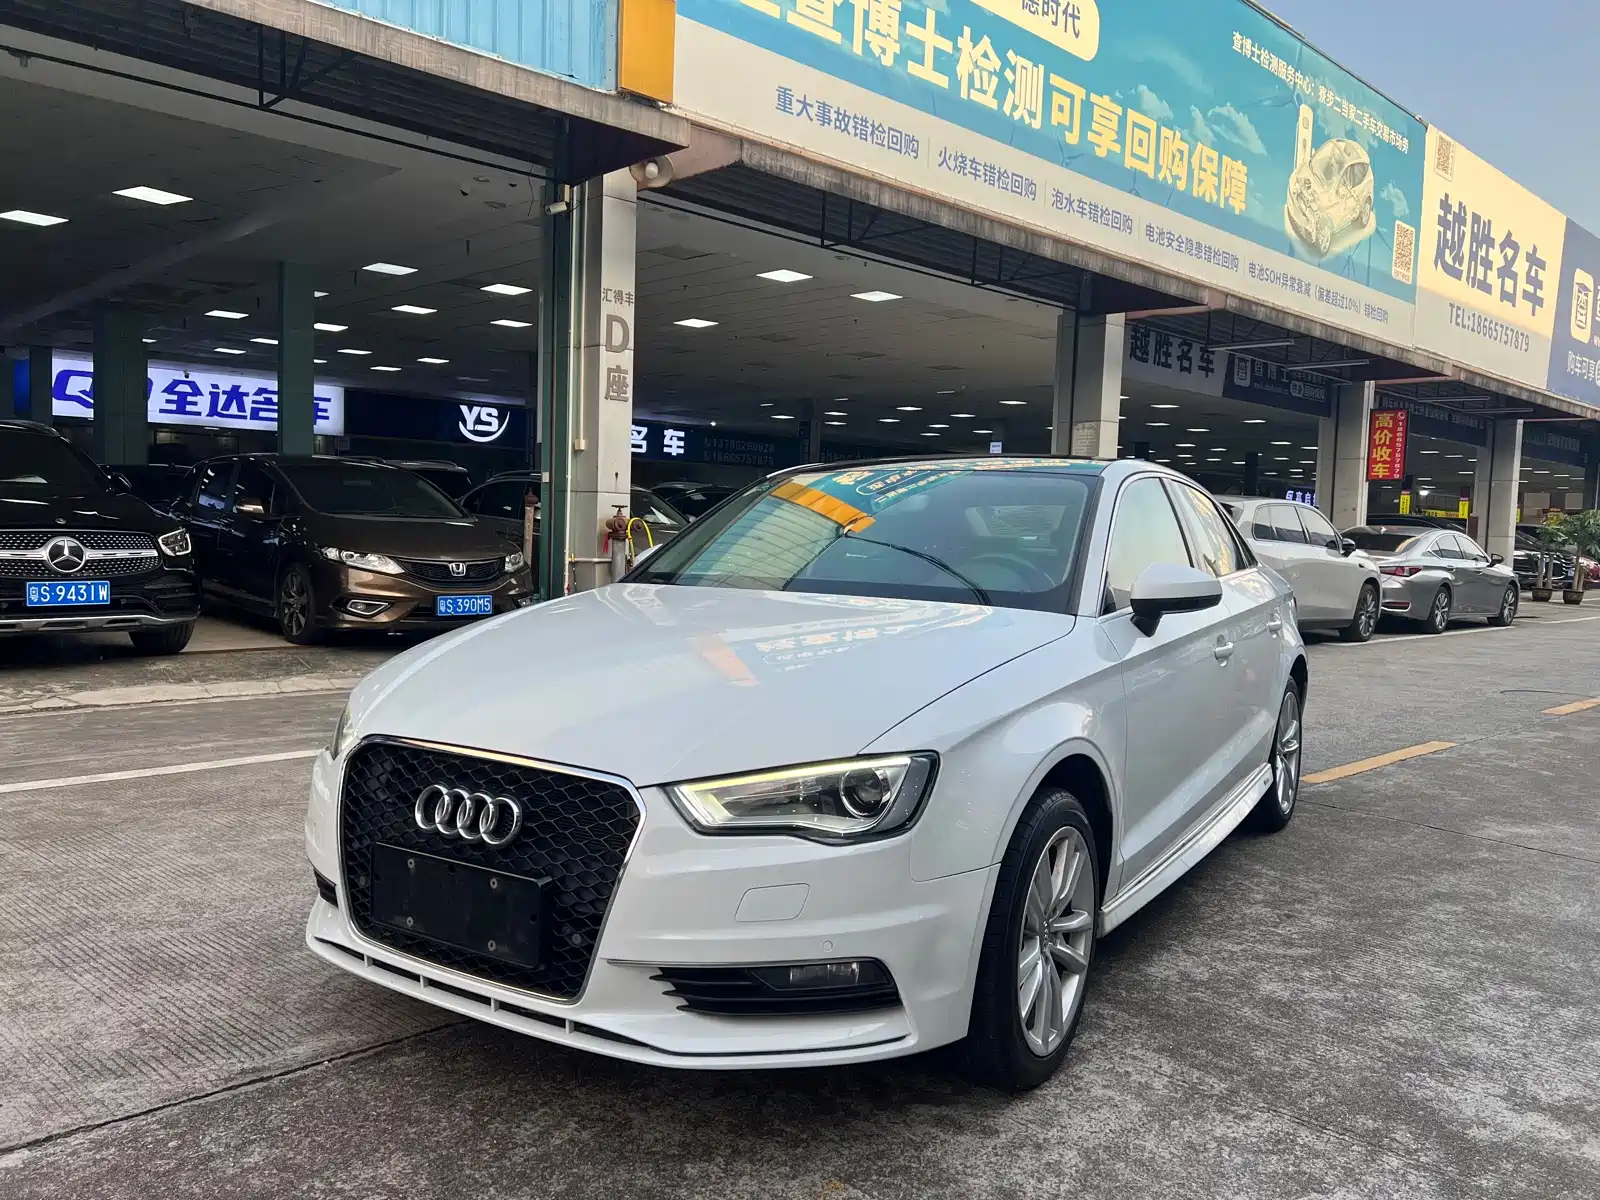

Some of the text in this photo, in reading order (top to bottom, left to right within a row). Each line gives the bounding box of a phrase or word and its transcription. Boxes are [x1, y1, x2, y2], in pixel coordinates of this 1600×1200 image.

[738, 0, 1248, 216] 博士检测可享回购保障
[775, 85, 920, 160] 重大事故错检回购
[938, 146, 1037, 201] 火烧车错检回购
[1051, 187, 1133, 236] 泡水车错检回购
[1145, 222, 1239, 273] 电池安全隐患错检回购
[1434, 192, 1547, 317] 越胜名车
[602, 287, 634, 307] 汇得丰
[1129, 324, 1216, 379] 越胜名车
[1449, 303, 1530, 353] TEL:18665757879
[459, 404, 499, 432] YS
[1371, 412, 1395, 479] 高价收车
